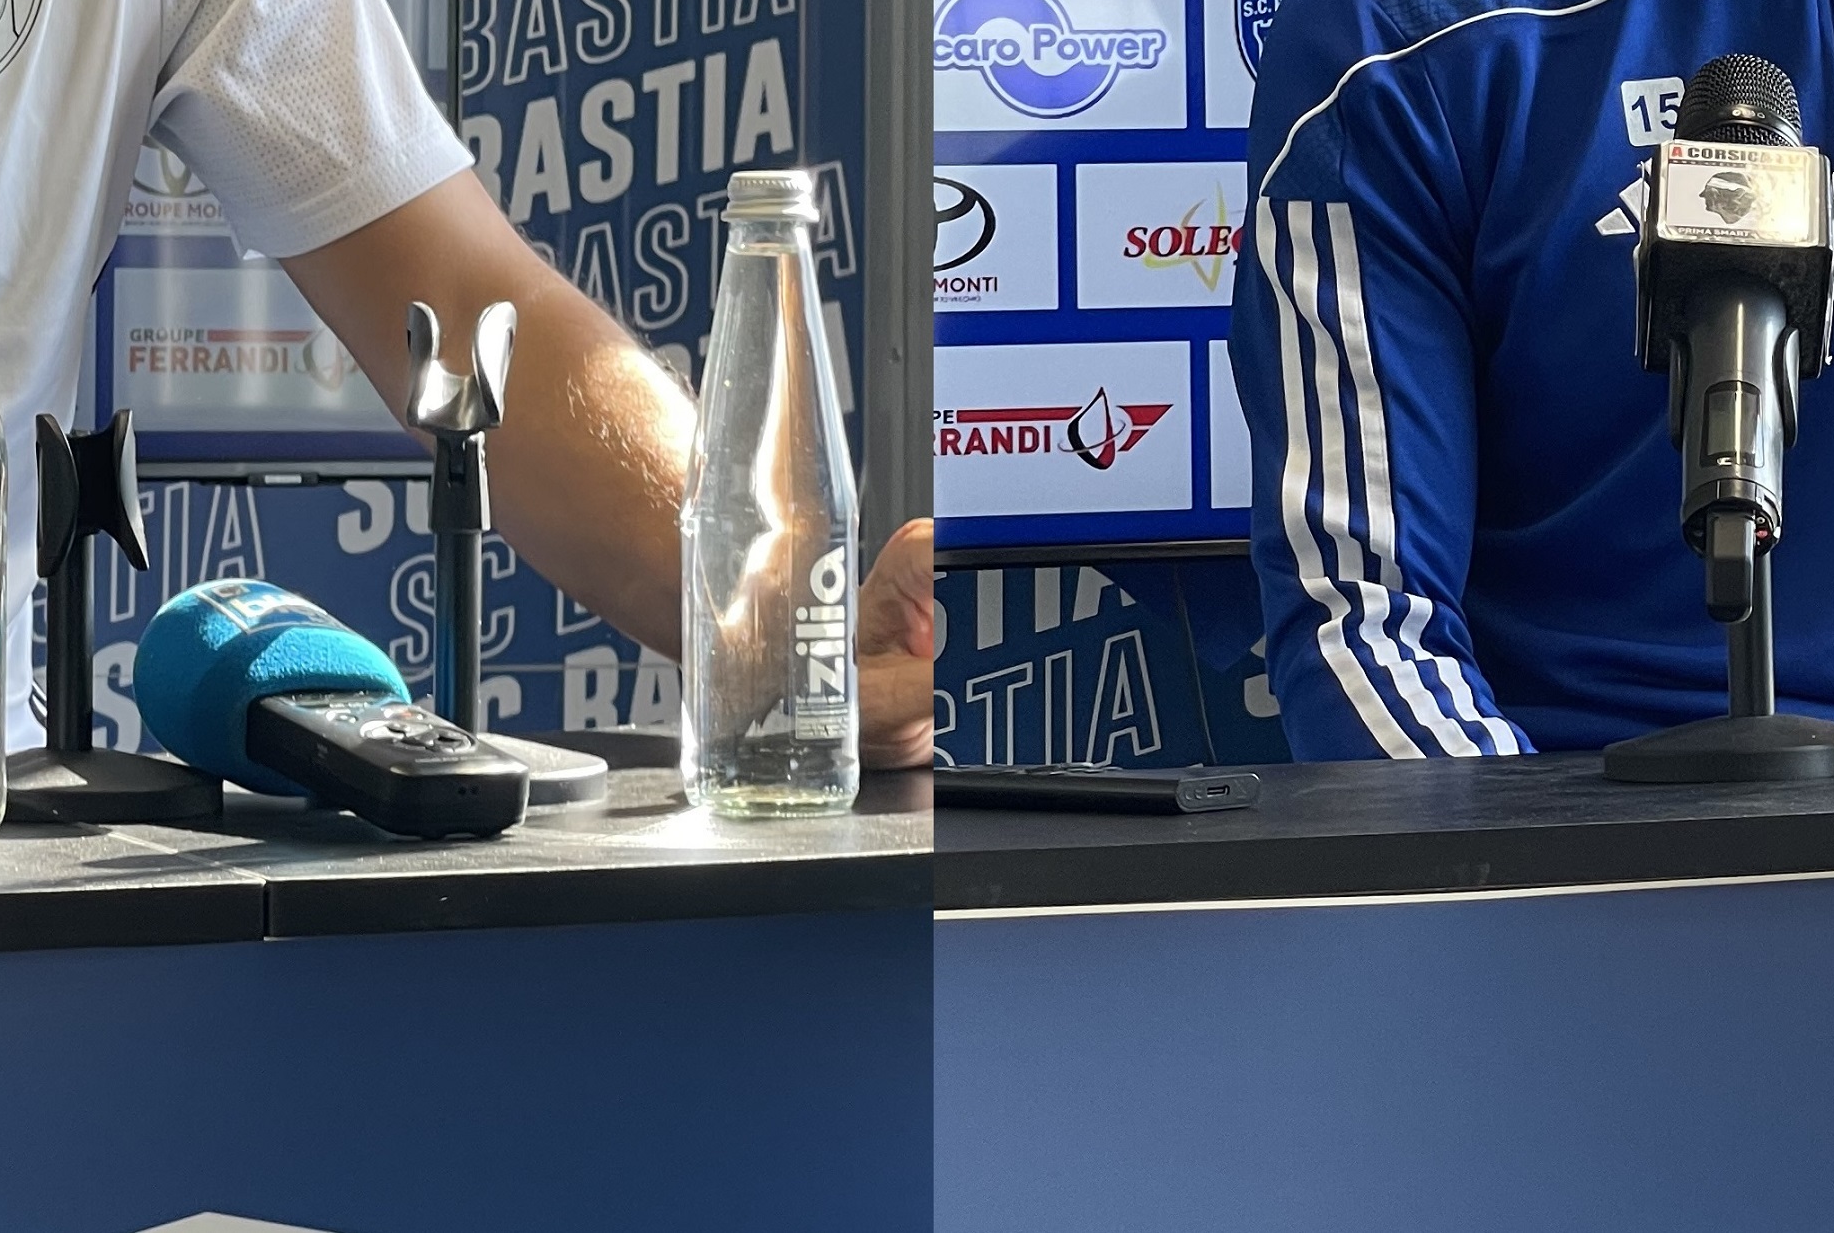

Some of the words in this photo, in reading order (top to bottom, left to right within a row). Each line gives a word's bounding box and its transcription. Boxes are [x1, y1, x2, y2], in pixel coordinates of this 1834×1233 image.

[934, 30, 1021, 63] caro
[1033, 26, 1160, 63] Power
[1631, 91, 1680, 134] 15
[1687, 146, 1773, 164] CORSICA
[123, 202, 183, 218] ROUPE
[1123, 224, 1242, 260] SOLE
[129, 328, 206, 343] GROUPE
[128, 345, 289, 374] FERRANDI
[934, 425, 1051, 457] RANDI
[795, 544, 846, 695] zilia
